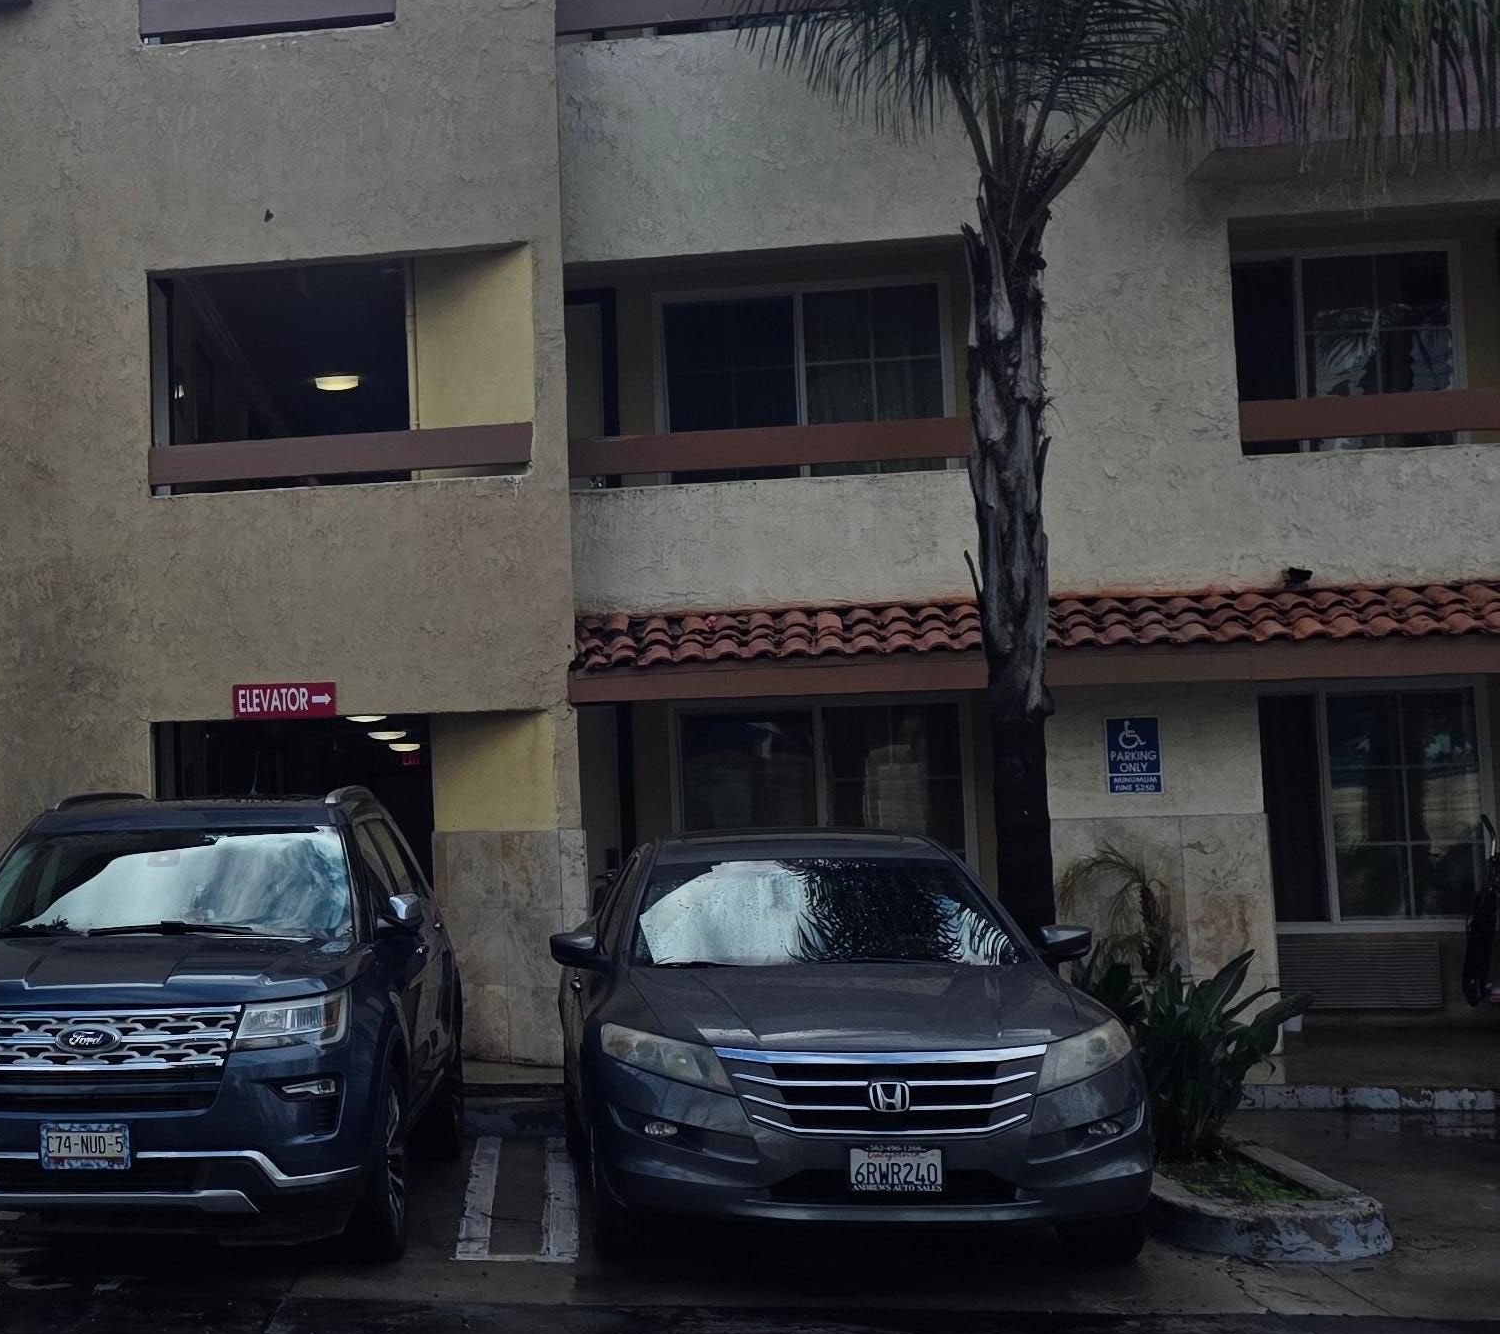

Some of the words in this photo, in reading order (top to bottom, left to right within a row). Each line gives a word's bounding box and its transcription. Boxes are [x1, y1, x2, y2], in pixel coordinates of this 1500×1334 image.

[238, 687, 309, 713] ELEVATOR
[1110, 750, 1157, 762] PARKING
[1120, 762, 1148, 773] ONLY
[68, 1030, 104, 1046] Ford
[47, 1135, 124, 1154] C74-NUD-5
[854, 1162, 938, 1185] 6RWR240
[893, 1184, 915, 1192] AUTO
[916, 1184, 942, 1192] SALES
